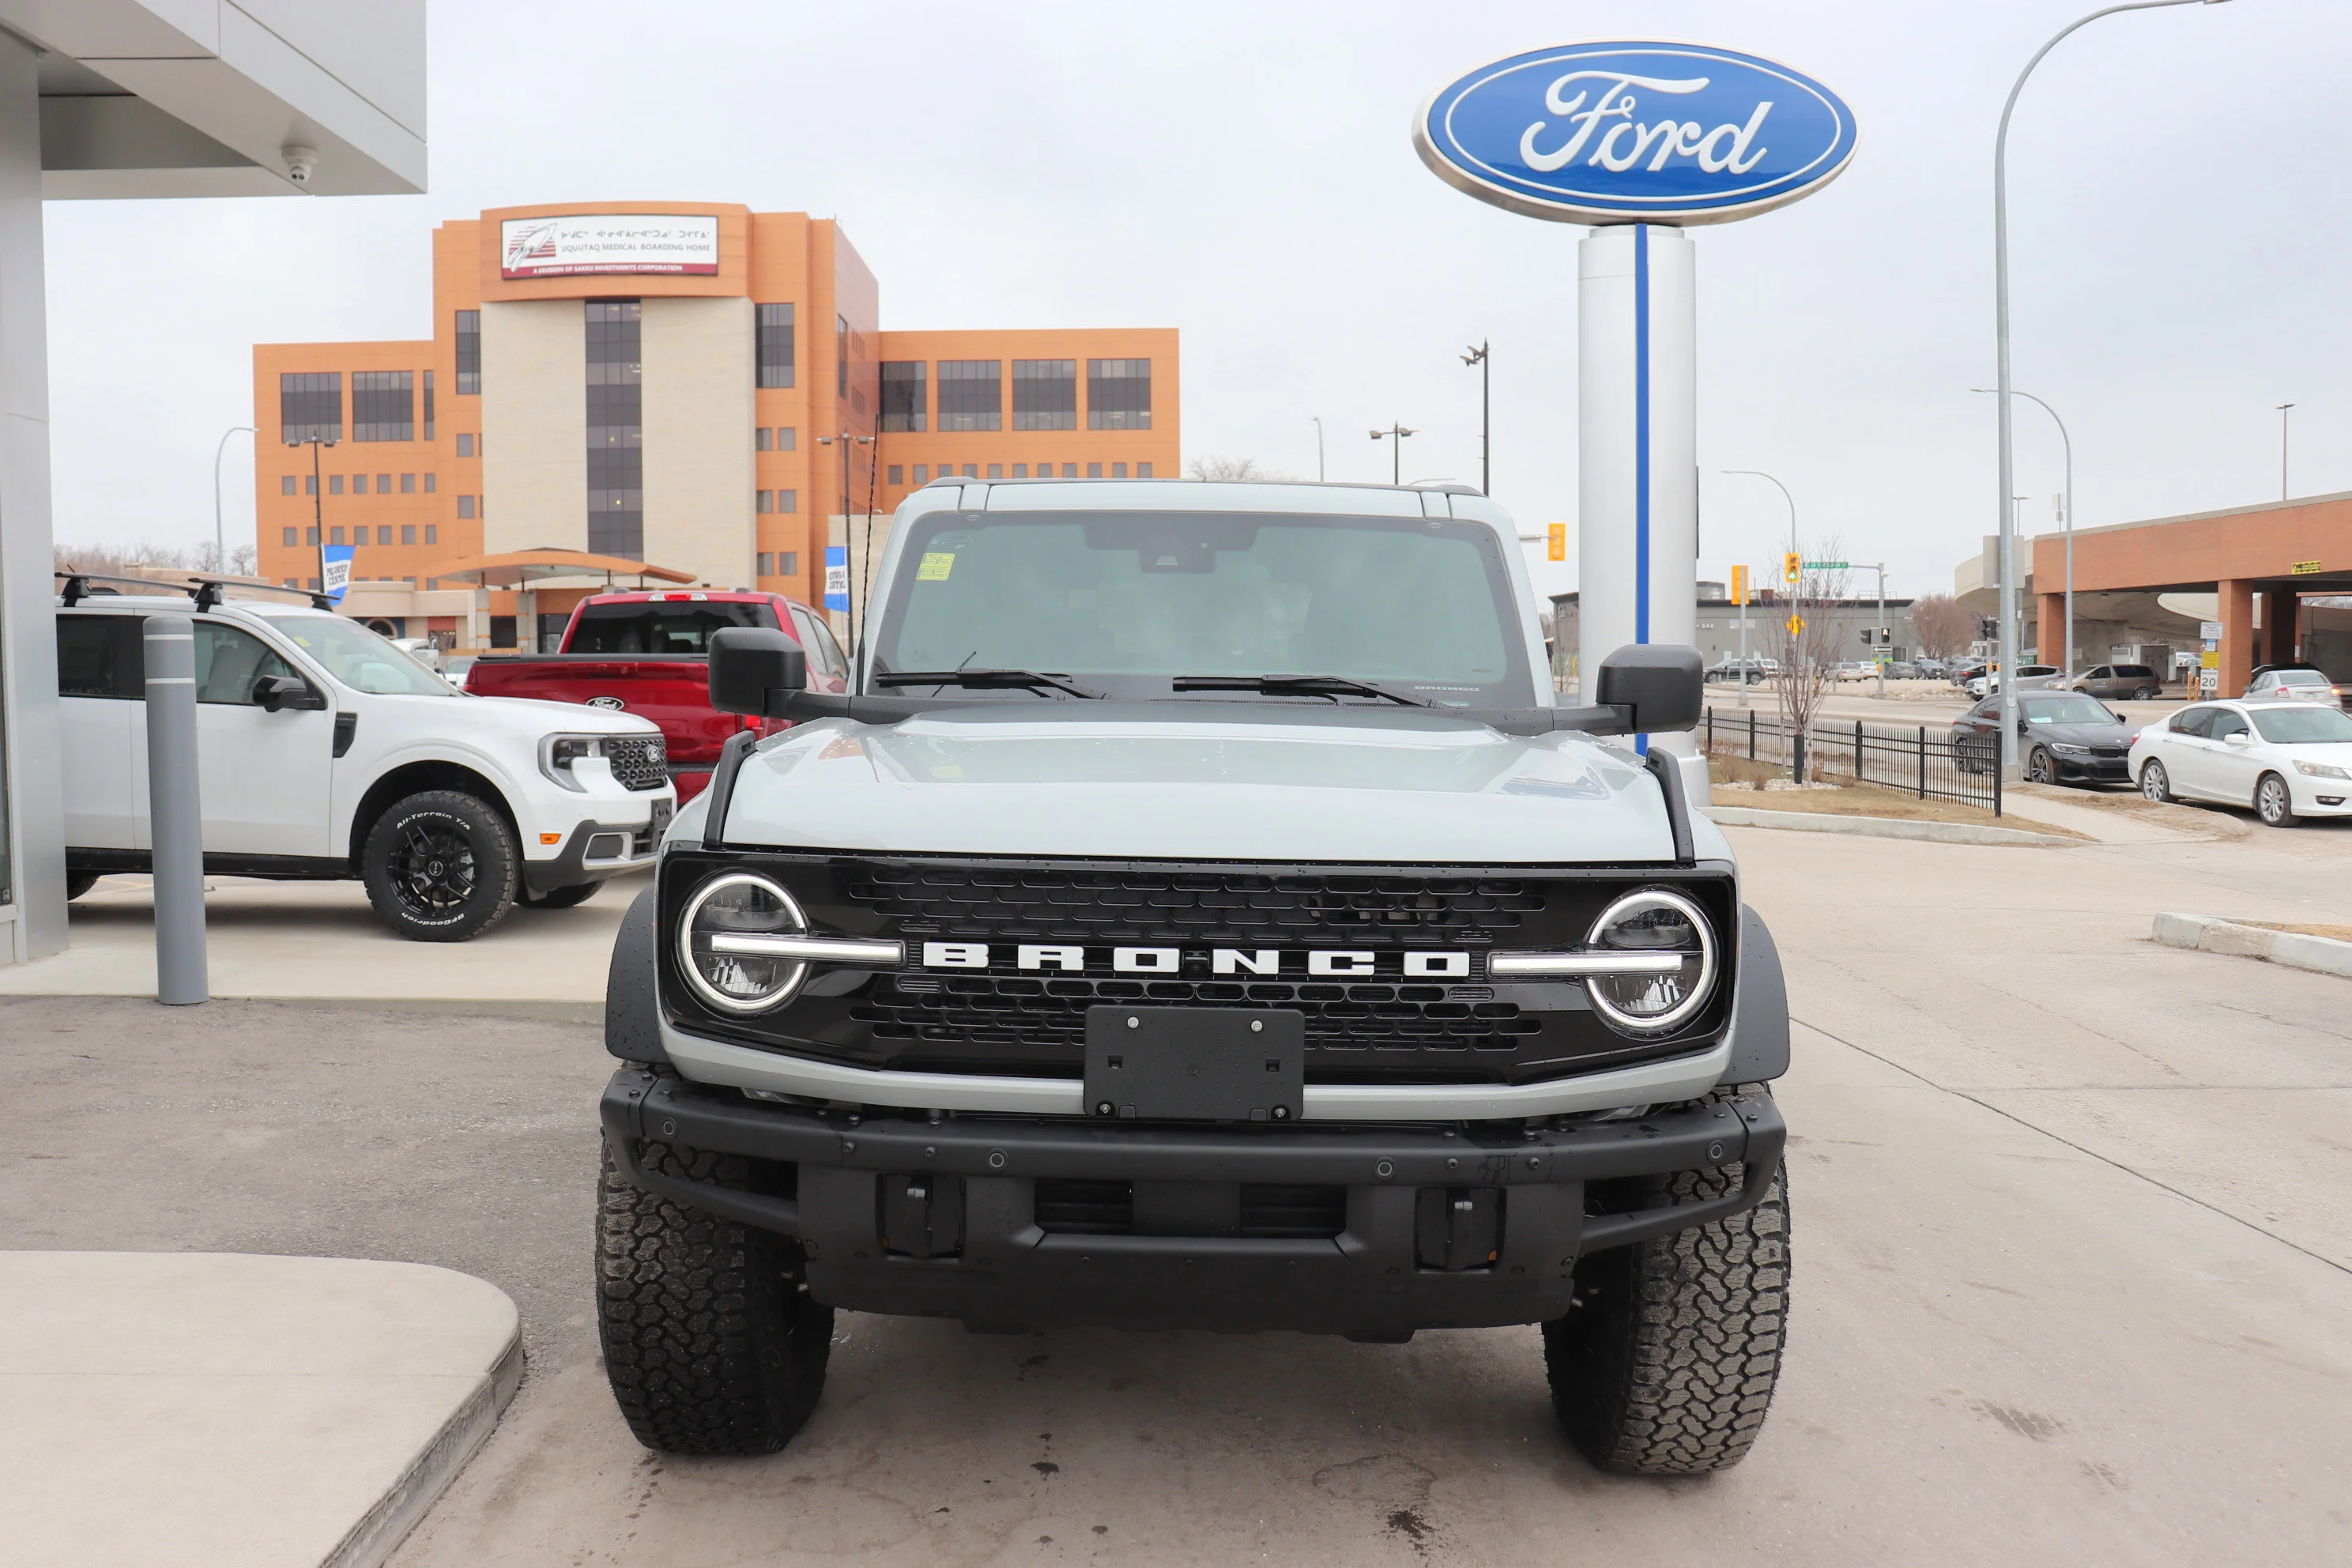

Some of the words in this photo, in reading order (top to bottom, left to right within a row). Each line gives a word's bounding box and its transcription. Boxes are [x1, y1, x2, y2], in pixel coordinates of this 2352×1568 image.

[1519, 70, 1774, 175] Ford
[560, 243, 601, 253] UQUUTAQ
[2202, 677, 2216, 687] 20
[397, 811, 452, 830] All-Terrain
[456, 817, 471, 830] T/A
[401, 912, 465, 925] BFGoodrich
[922, 941, 1471, 978] BRONCO
